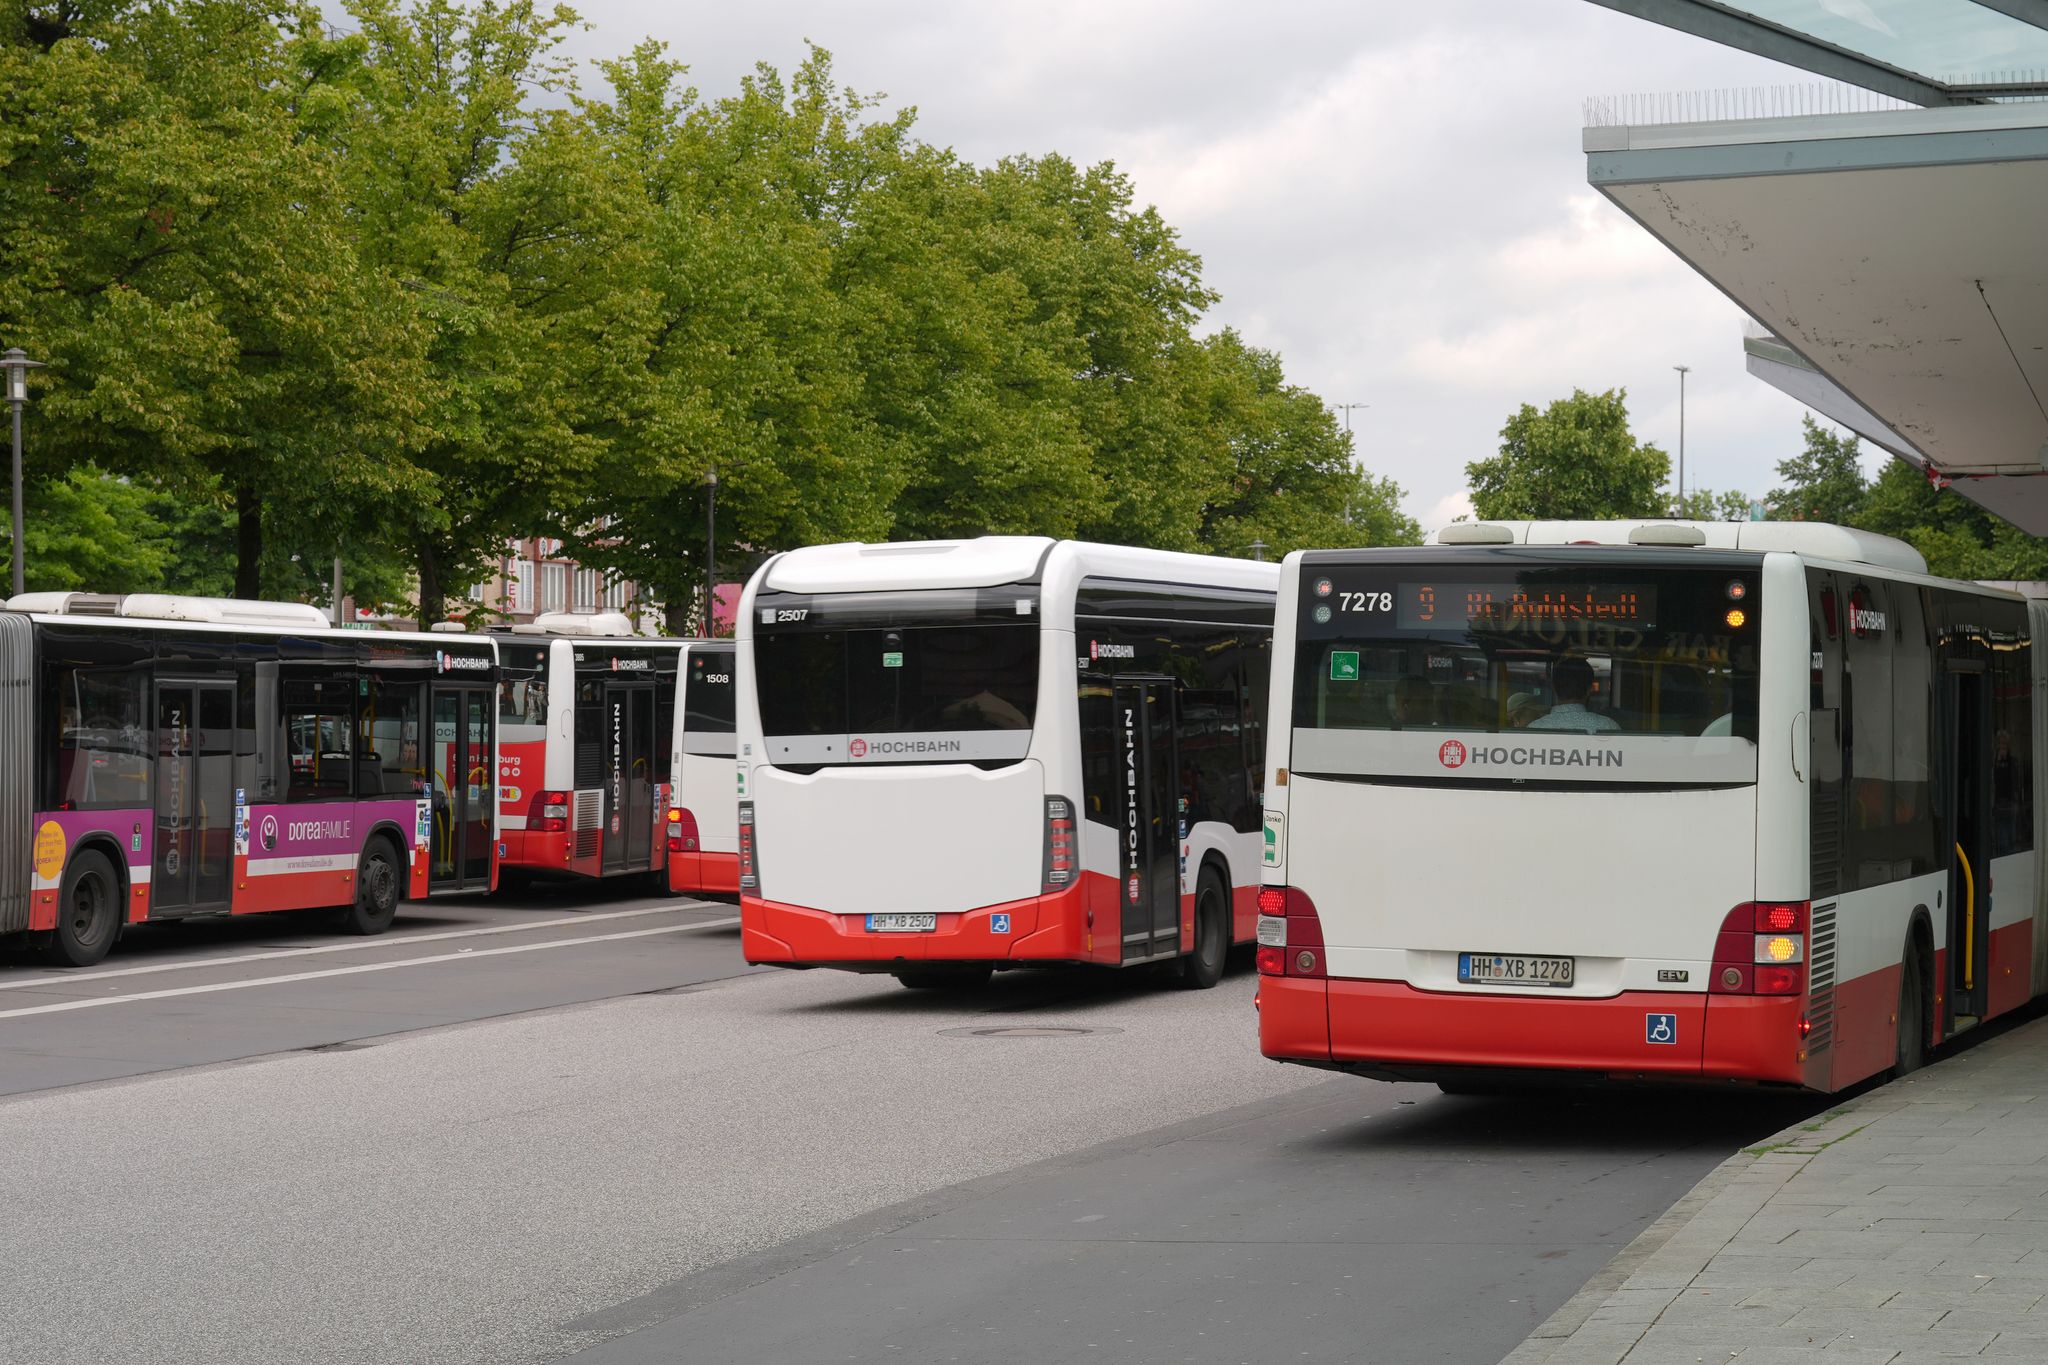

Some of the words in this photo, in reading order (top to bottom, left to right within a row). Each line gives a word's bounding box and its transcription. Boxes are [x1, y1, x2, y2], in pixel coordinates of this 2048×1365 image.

[1339, 592, 1393, 612] 7278
[1418, 586, 1435, 621] 9
[777, 609, 809, 622] 2507
[1856, 609, 1886, 631] HOCHBAHN
[1097, 644, 1135, 658] HOCHBAHN
[451, 657, 489, 670] HOCHBAHN
[617, 659, 649, 670] HOCHBAHN
[705, 674, 730, 685] 1508
[870, 740, 961, 754] HOCHBAHN
[1471, 747, 1623, 767] HOCHBAHN
[170, 709, 181, 845] HOCHBAHN
[1125, 709, 1138, 869] HOCHBAHN
[873, 915, 887, 928] HH
[895, 915, 907, 928] XB
[909, 915, 935, 928] 2507
[1471, 958, 1492, 977] HH
[1504, 959, 1525, 978] XB
[1530, 961, 1570, 979] 1278
[1659, 970, 1687, 982] EEV
